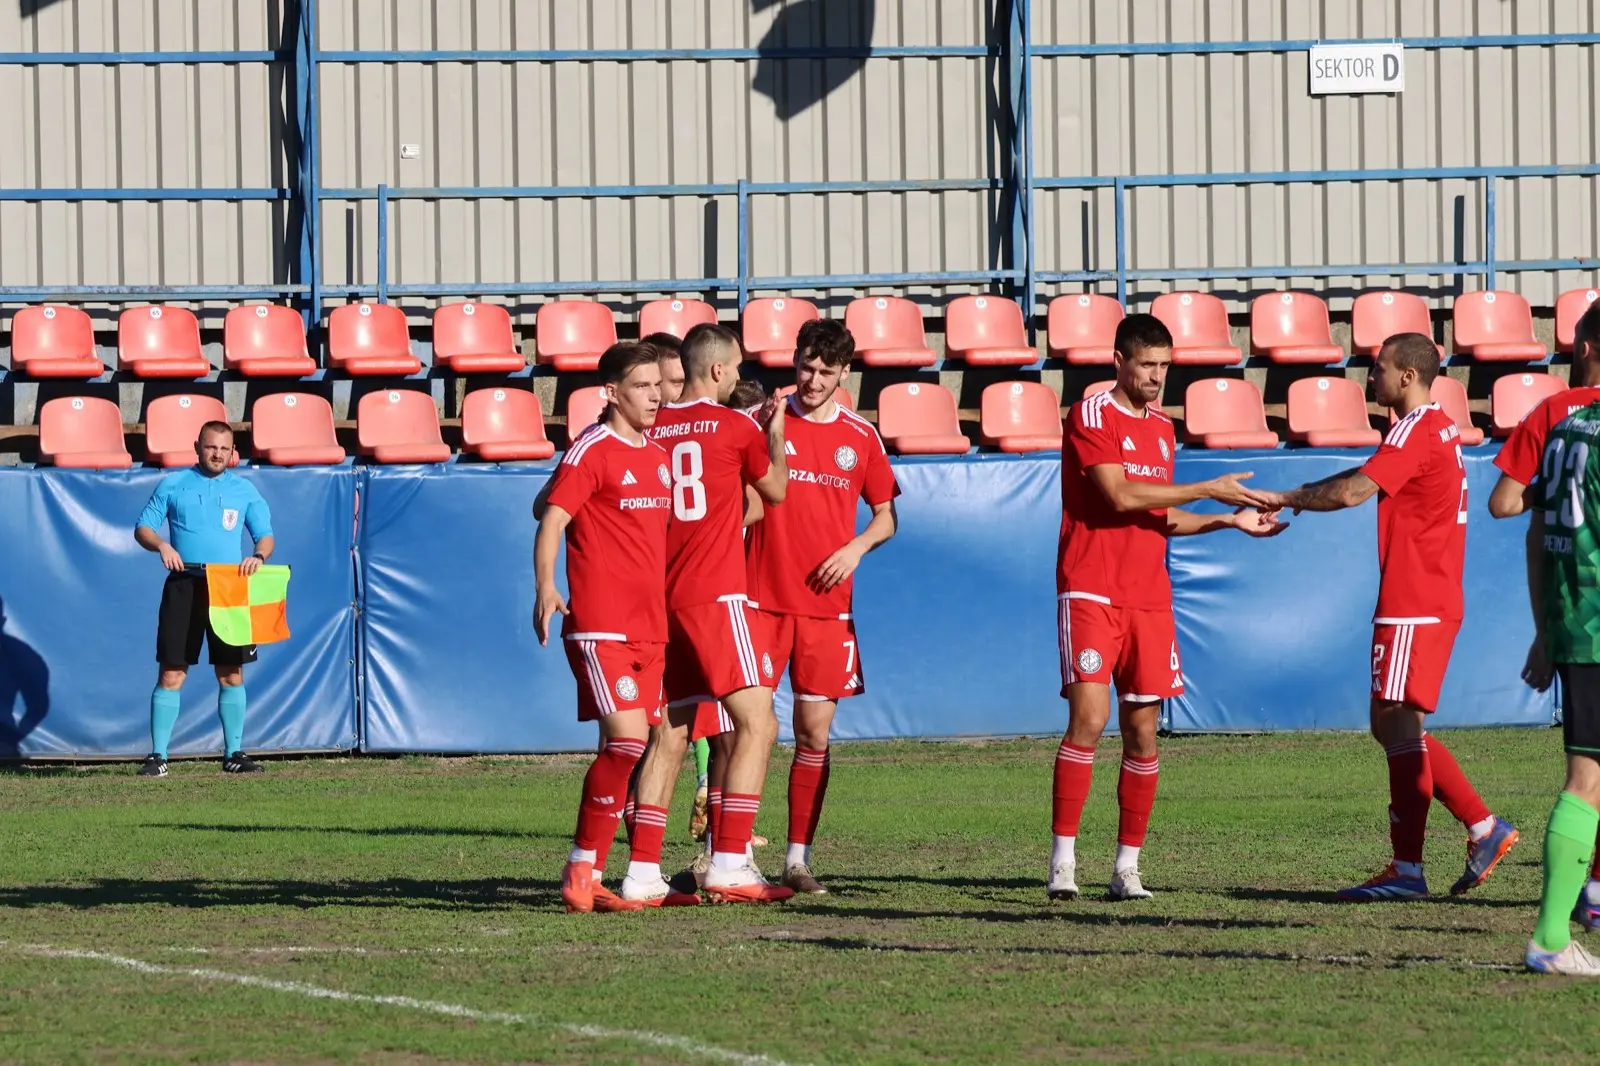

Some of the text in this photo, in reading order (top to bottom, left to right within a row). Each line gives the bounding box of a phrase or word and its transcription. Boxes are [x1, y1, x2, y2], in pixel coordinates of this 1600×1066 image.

[1315, 53, 1399, 81] SEKTOR D
[653, 422, 691, 440] ZAGREB
[693, 420, 719, 434] CITY
[672, 441, 707, 522] 8
[789, 468, 851, 491] RZAMOTORS
[1543, 437, 1589, 528] 23
[620, 497, 671, 510] FORZAMOTOR
[842, 640, 855, 672] 7
[1170, 639, 1180, 671] 6
[1372, 643, 1386, 675] 2
